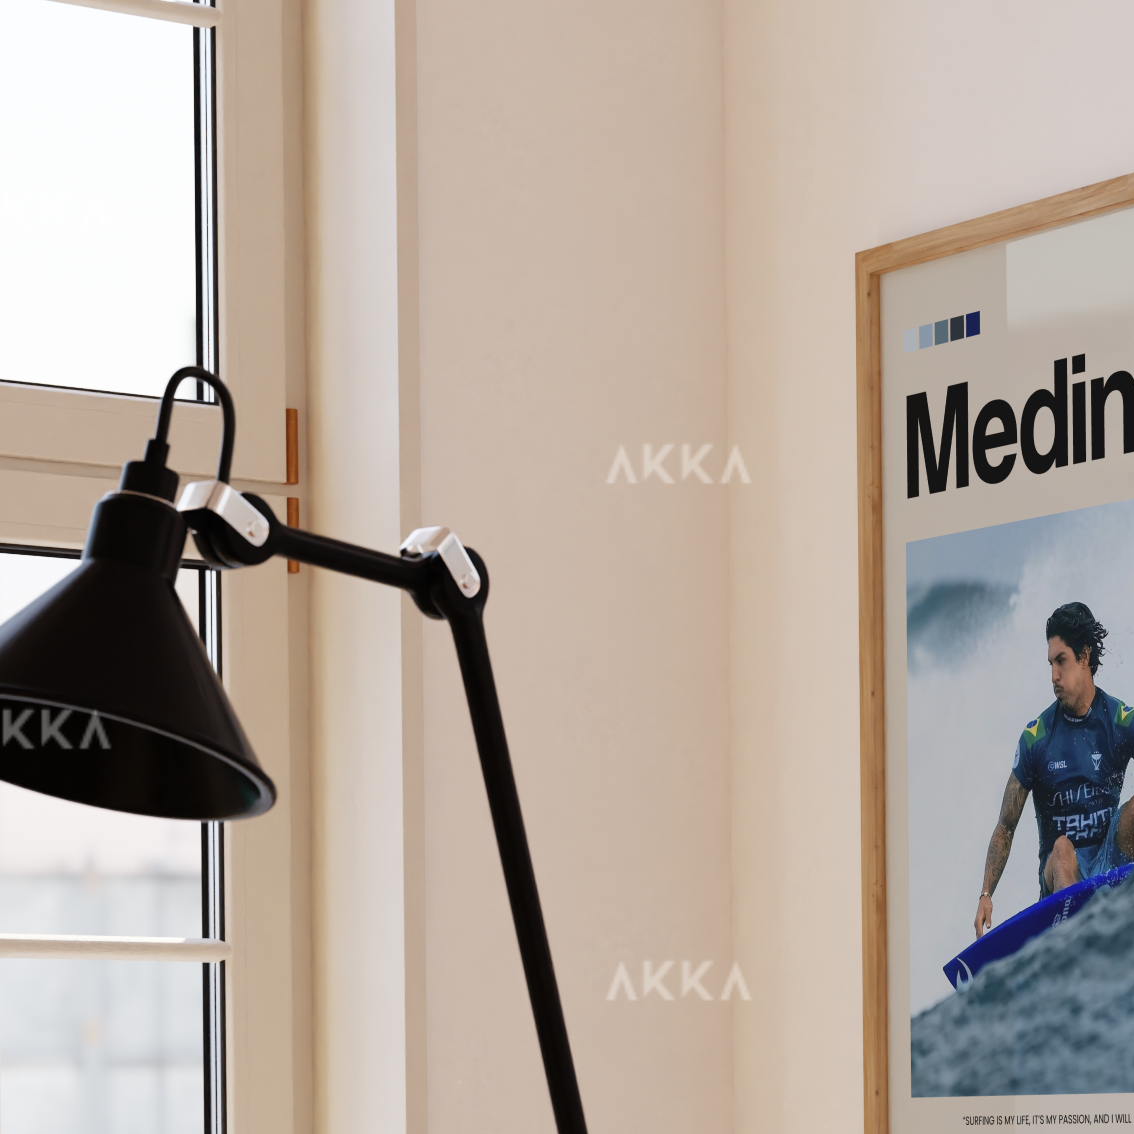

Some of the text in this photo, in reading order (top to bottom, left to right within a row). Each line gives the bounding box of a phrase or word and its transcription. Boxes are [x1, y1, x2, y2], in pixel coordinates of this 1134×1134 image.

[1054, 760, 1067, 770] WSL
[997, 1116, 1003, 1125] IS
[1005, 1116, 1015, 1125] MY
[1017, 1115, 1030, 1126] LIFE,
[1033, 1115, 1045, 1125] IT'S
[1046, 1115, 1057, 1124] MY
[1059, 1114, 1092, 1125] PASSION,
[1094, 1114, 1110, 1124] AND
[1112, 1114, 1113, 1123] I
[1115, 1114, 1132, 1124] WILL
